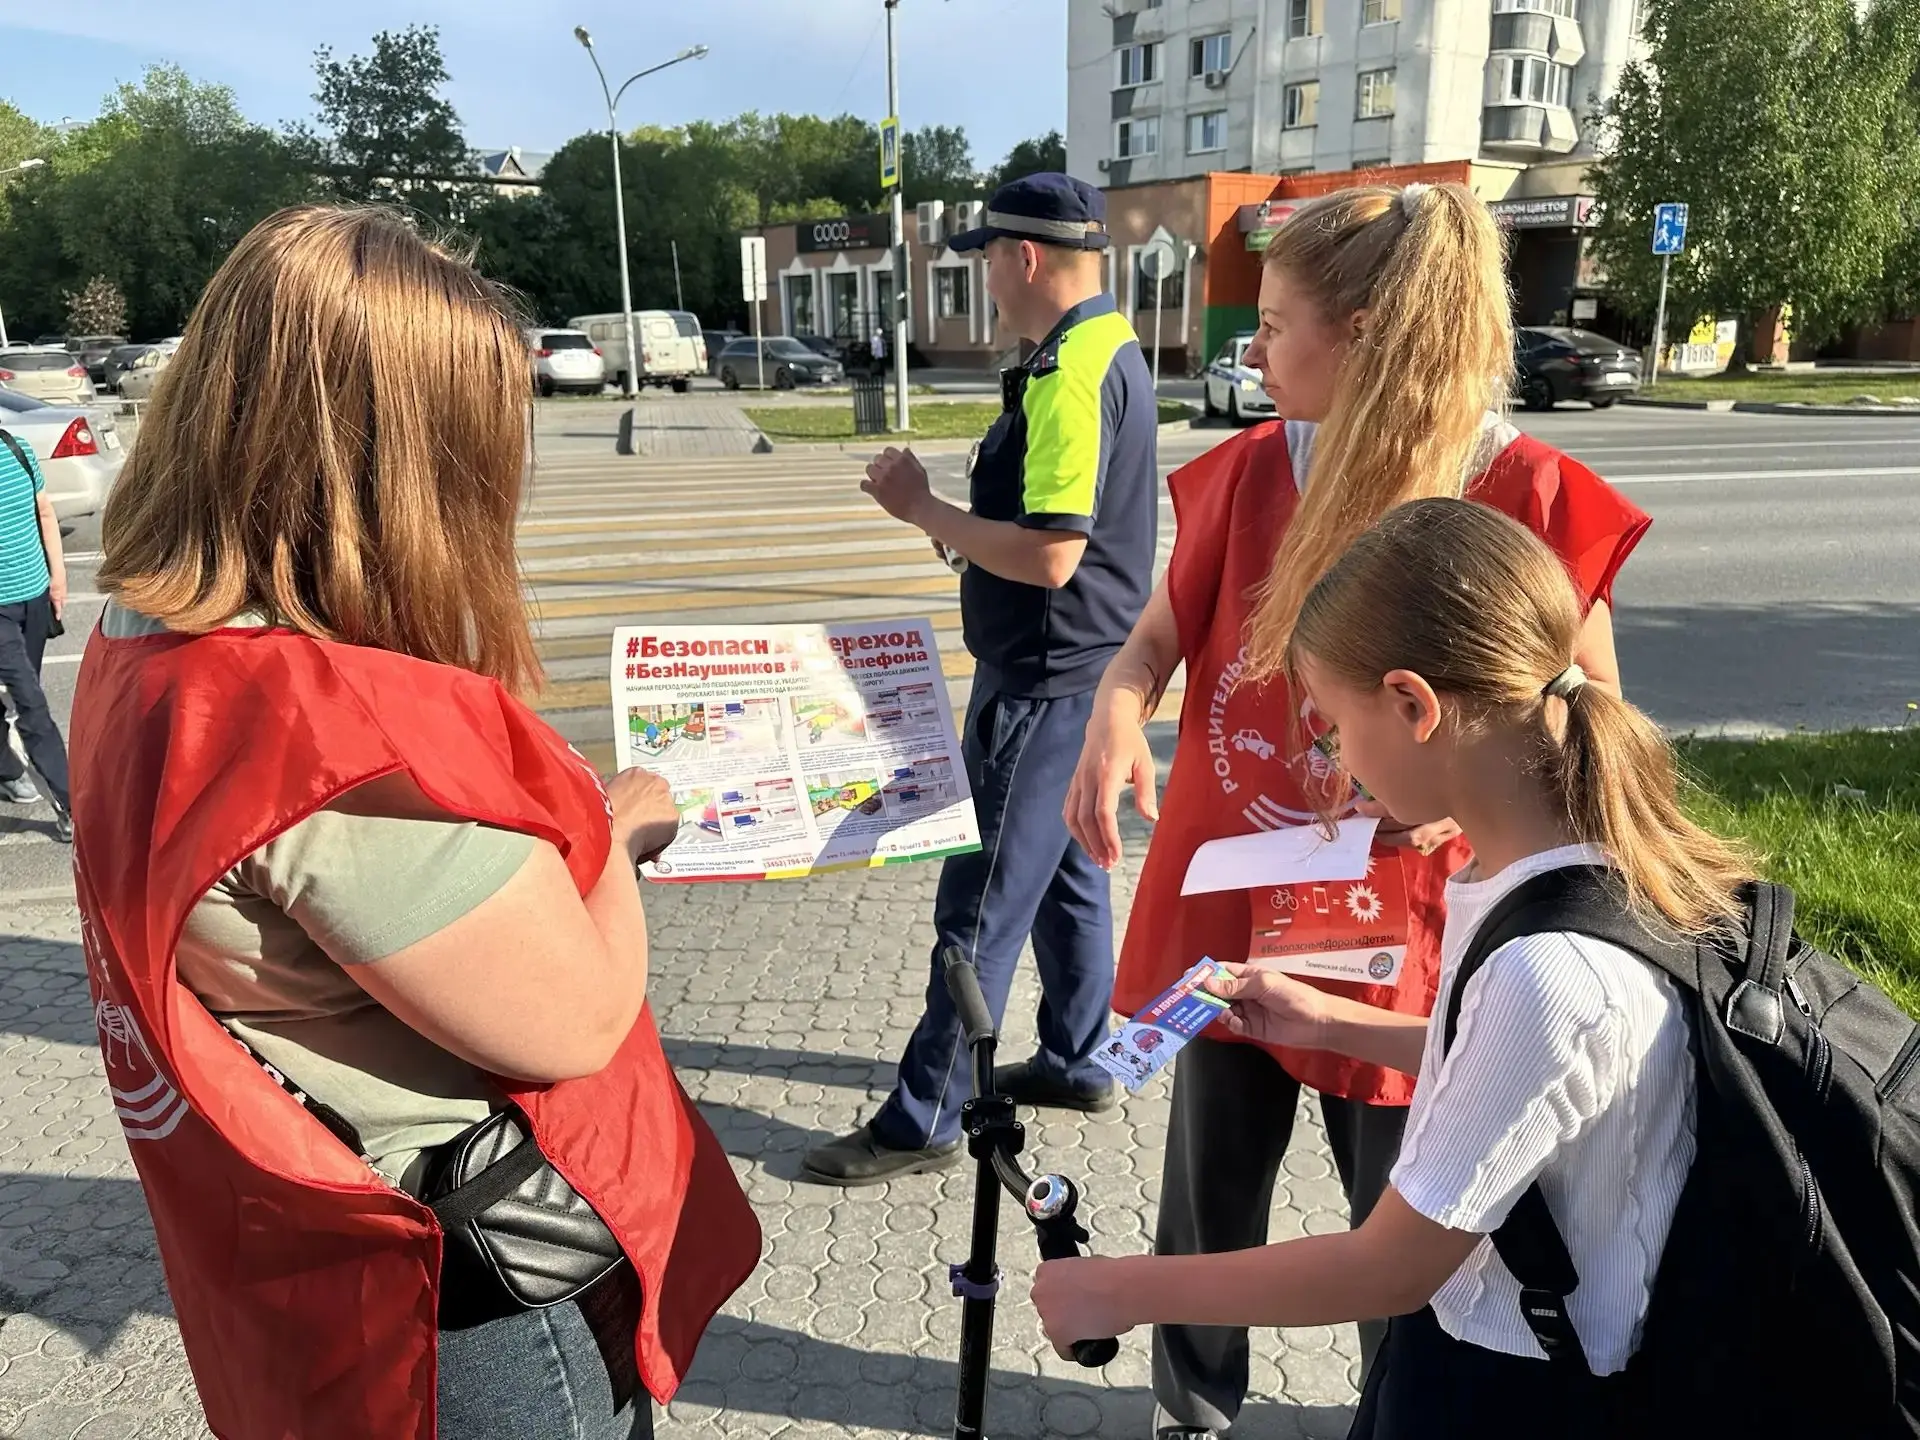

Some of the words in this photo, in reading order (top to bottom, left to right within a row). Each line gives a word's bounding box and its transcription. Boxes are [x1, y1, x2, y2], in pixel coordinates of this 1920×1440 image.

[1496, 203, 1526, 214] АЛОН
[1527, 201, 1569, 214] ЦВЕТОВ
[626, 662, 786, 681] #БезНаушников
[626, 684, 654, 692] НАЧИНАЯ
[655, 683, 680, 691] ПЕРЕХОД
[753, 678, 781, 686] ПЕРЕХОУ,
[781, 676, 810, 685] УБЕДИТЕС
[874, 670, 898, 678] ПОЛОСАХ
[676, 690, 714, 698] ПРОПУСКАЮТ
[1208, 646, 1251, 794] РОДИТЕЛЬС
[1261, 935, 1395, 954] #БезопасныеДорогиДетям
[1305, 960, 1338, 971] Тюменская
[1339, 964, 1364, 974] область
